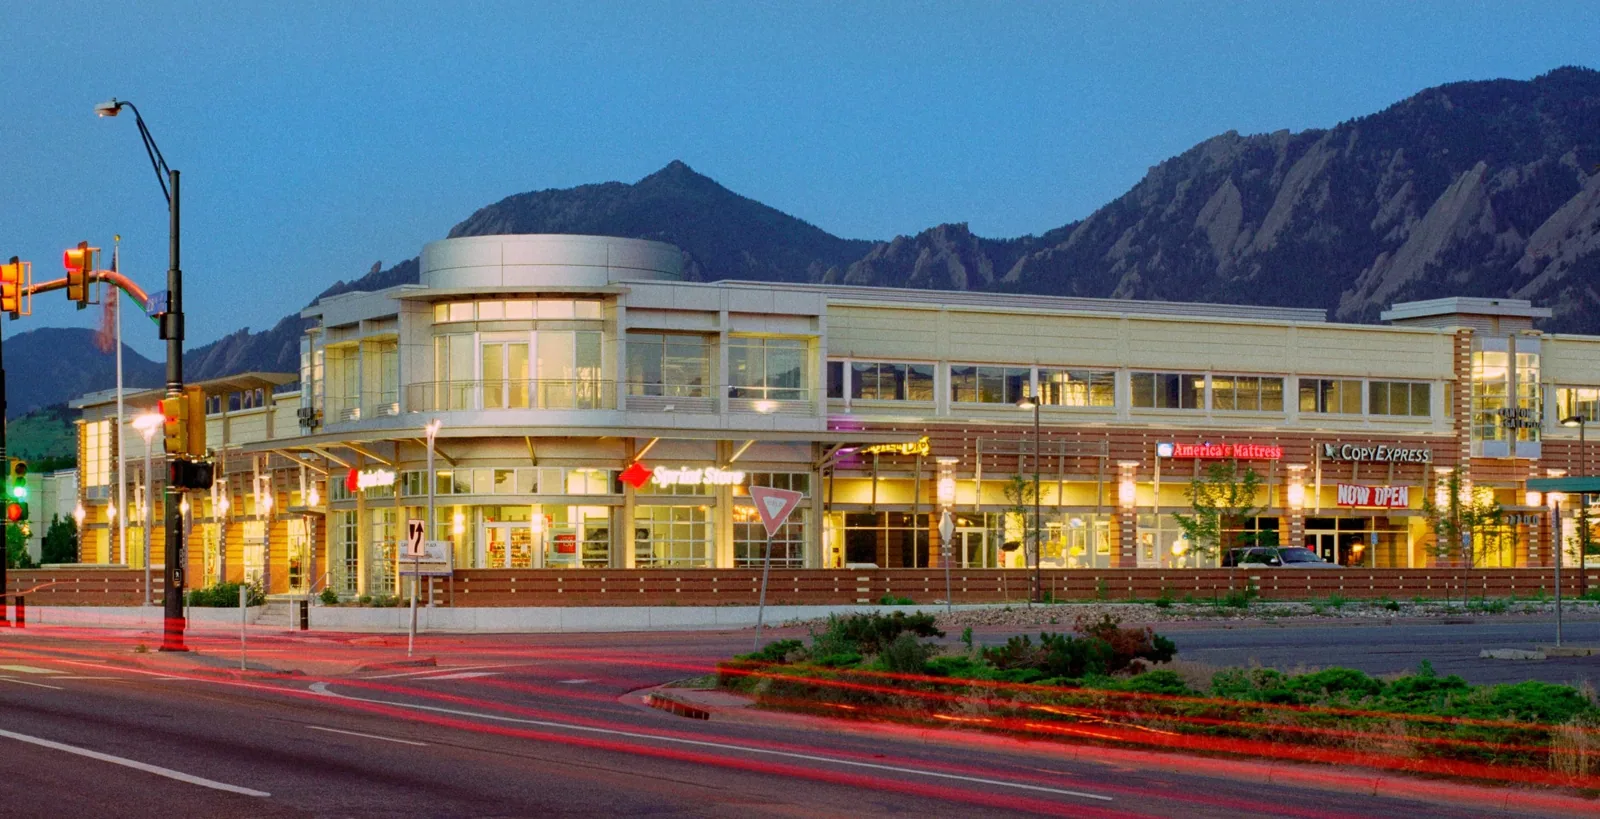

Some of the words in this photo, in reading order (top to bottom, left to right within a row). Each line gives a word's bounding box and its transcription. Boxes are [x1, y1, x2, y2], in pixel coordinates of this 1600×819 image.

[1173, 441, 1232, 458] America's
[1233, 443, 1282, 458] Mattress
[651, 465, 702, 489] Sprint
[702, 466, 746, 486] Store
[1337, 484, 1370, 505] NOW
[1374, 486, 1408, 506] OPEN
